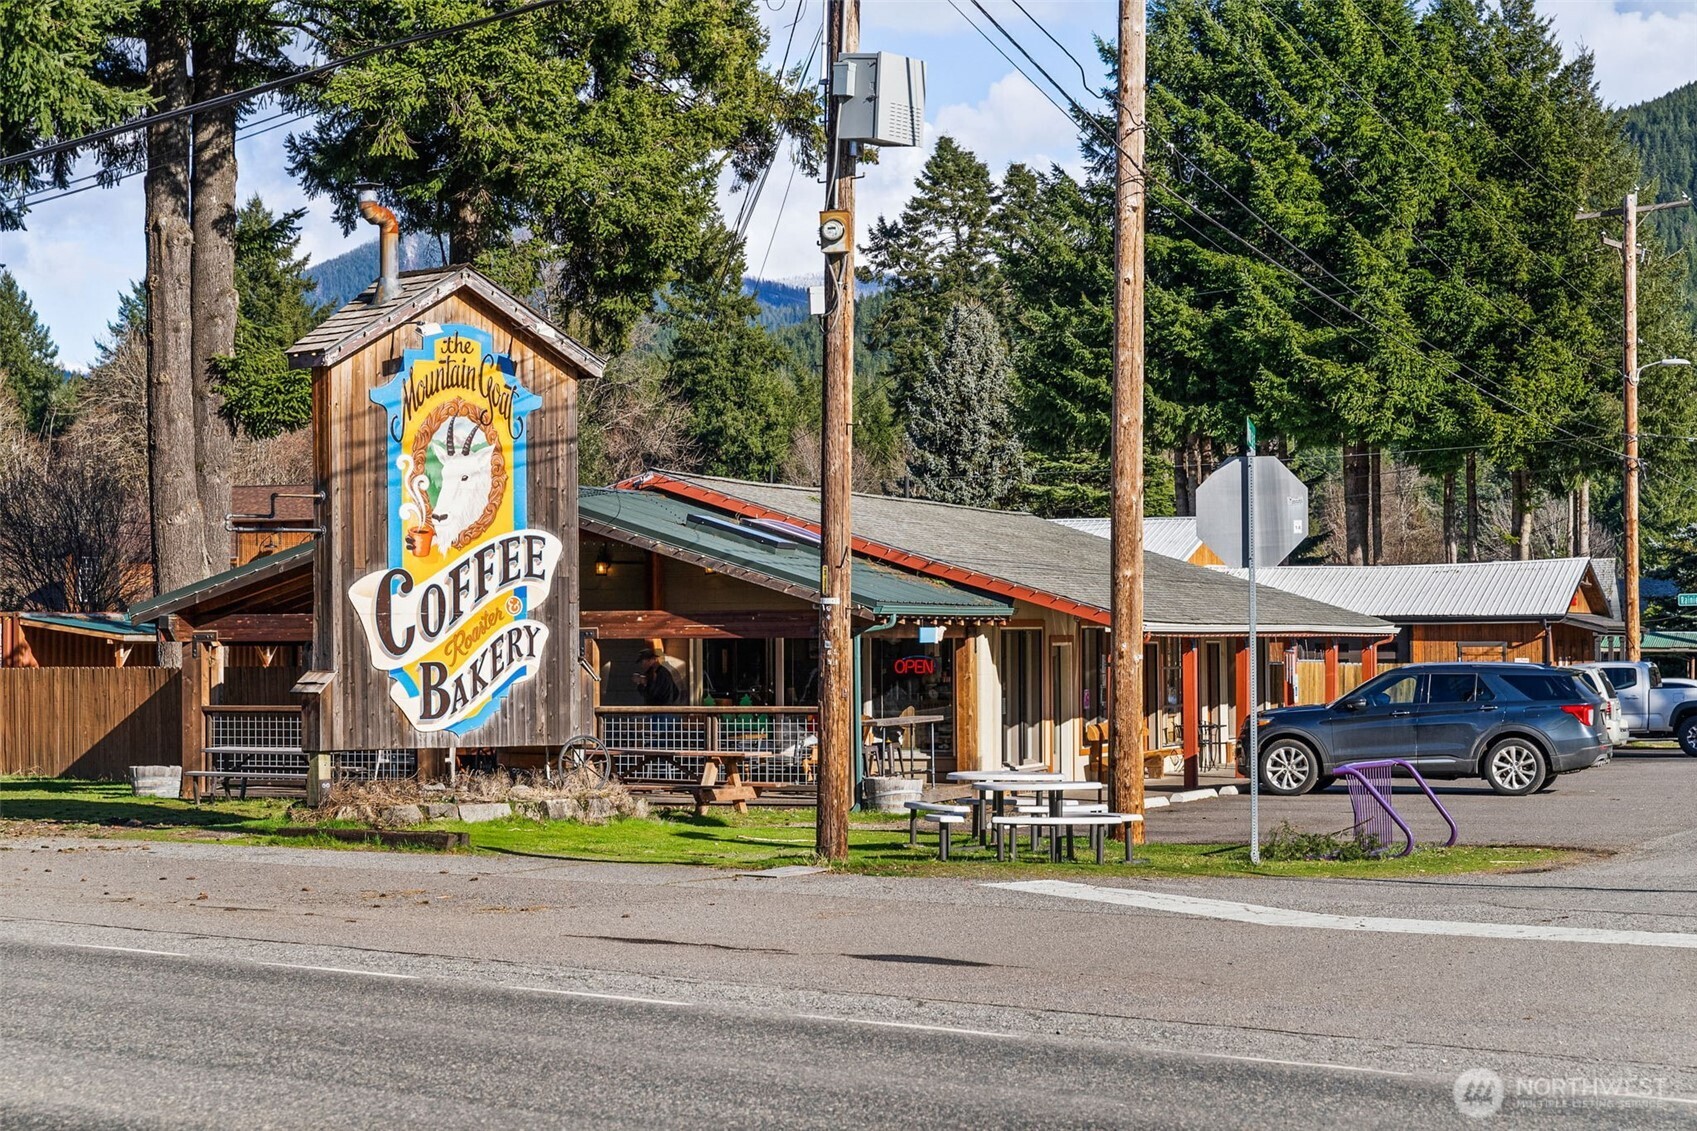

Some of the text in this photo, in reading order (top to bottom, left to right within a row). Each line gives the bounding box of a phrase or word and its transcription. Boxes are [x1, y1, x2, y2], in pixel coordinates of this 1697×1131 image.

[441, 331, 474, 354] the
[391, 353, 524, 443] Mountain Goat
[375, 534, 546, 656] COFFEE
[419, 624, 541, 720] BAKERY
[444, 606, 505, 667] Roaster
[894, 659, 935, 675] OPEN
